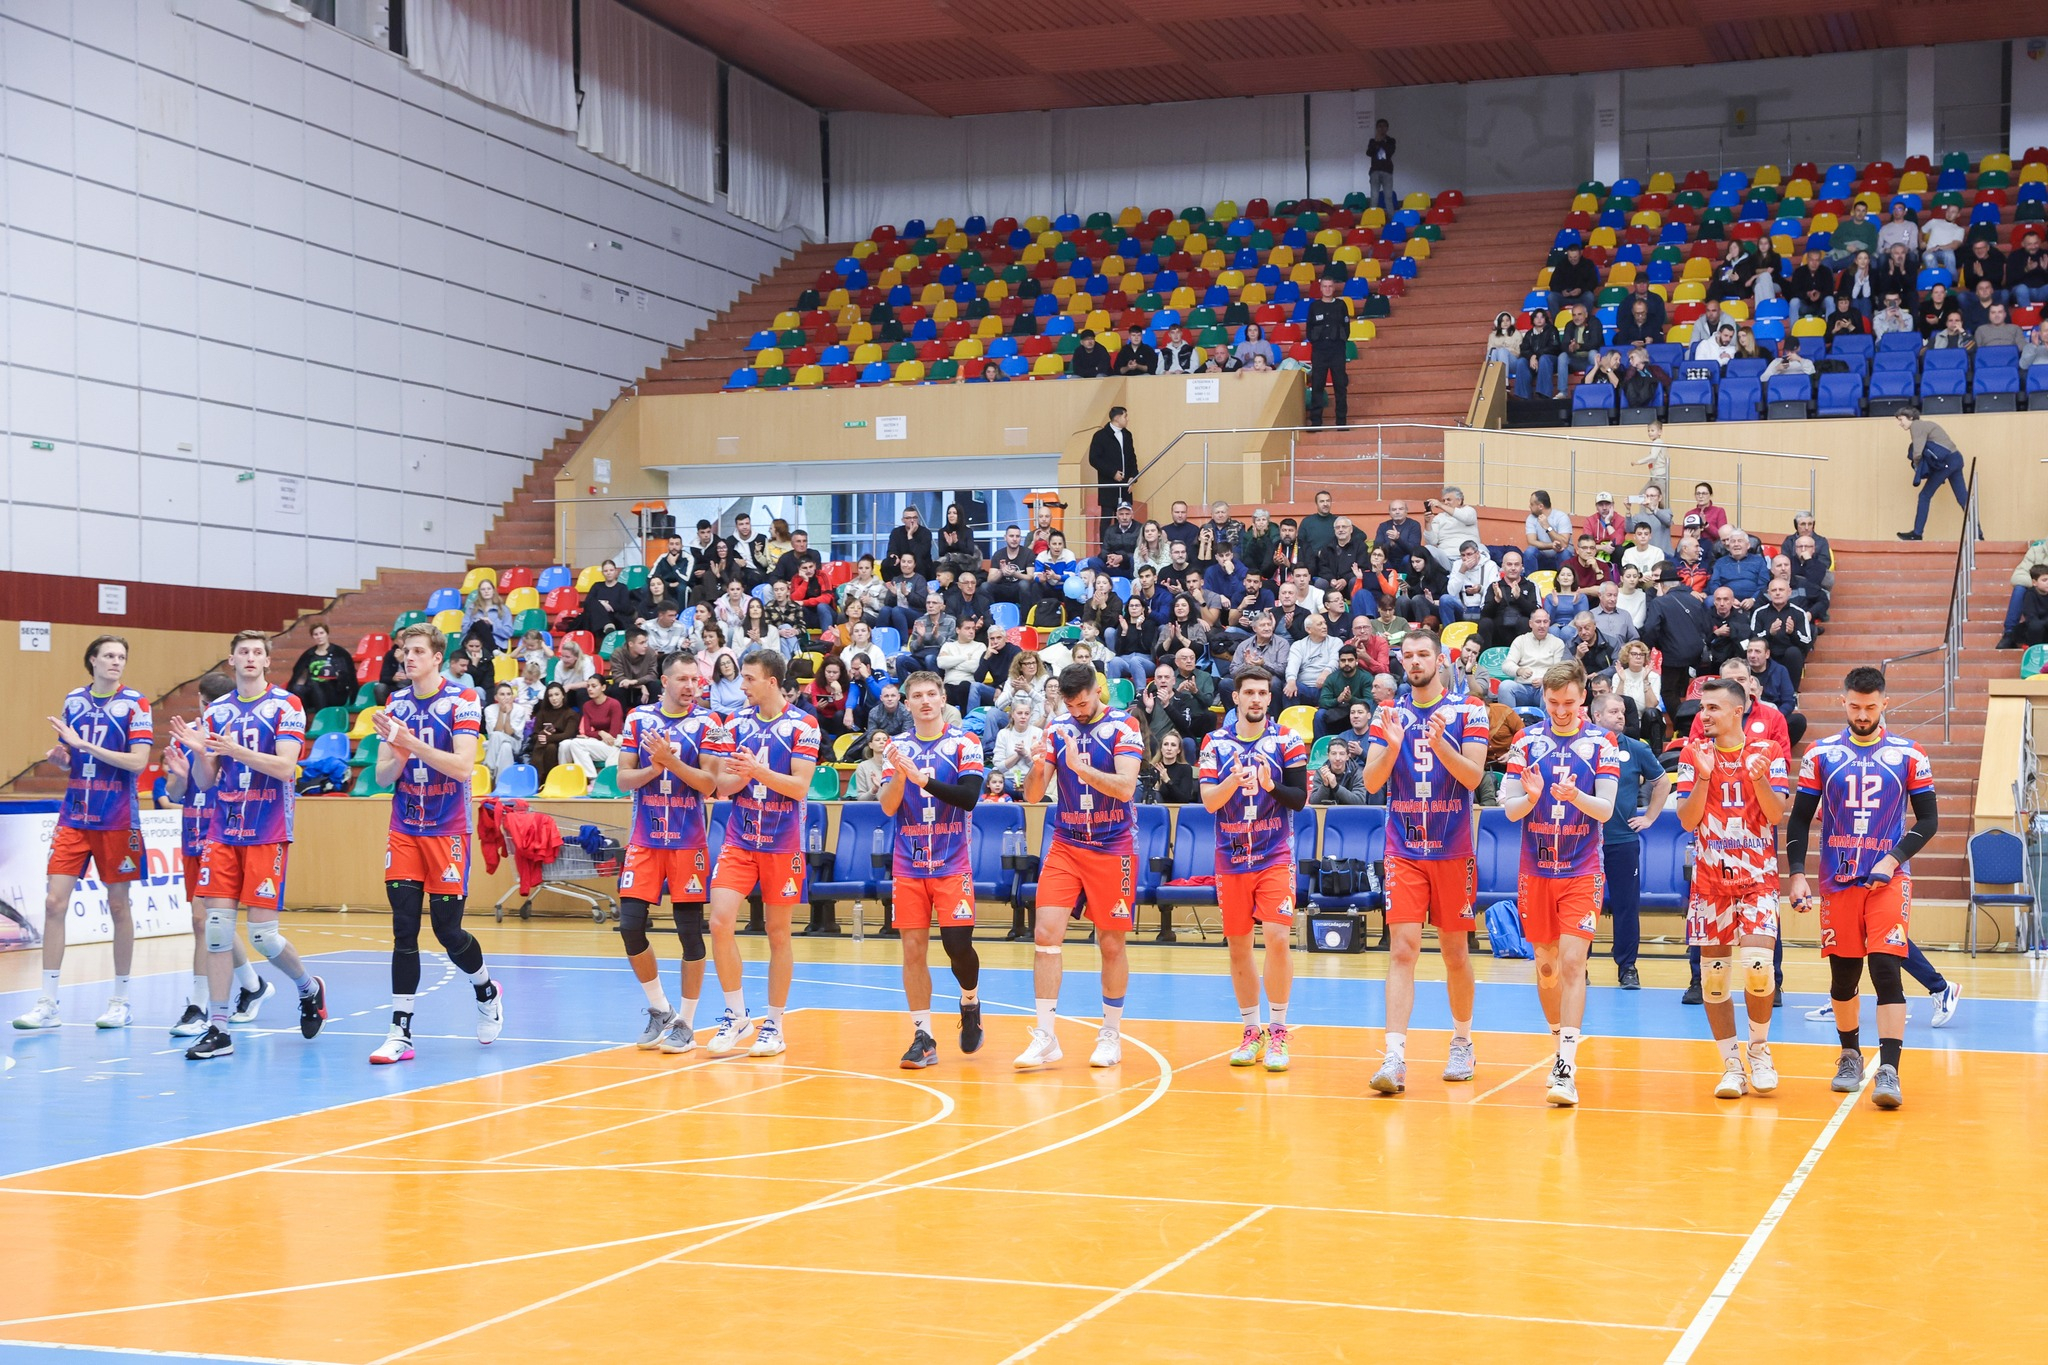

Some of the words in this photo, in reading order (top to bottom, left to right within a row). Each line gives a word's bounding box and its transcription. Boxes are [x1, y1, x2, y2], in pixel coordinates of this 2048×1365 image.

[21, 627, 49, 635] SECTOR
[32, 637, 39, 648] C
[80, 724, 108, 753] 17
[1414, 738, 1434, 772] 5
[1552, 765, 1571, 783] 7
[1720, 781, 1745, 808] 11
[1844, 774, 1883, 809] 12
[450, 835, 462, 862] PCF
[1405, 840, 1443, 849] CAPITAL
[1537, 860, 1572, 869] CAPITAL
[198, 867, 210, 885] 3
[1121, 855, 1131, 897] ISPCF
[1688, 916, 1708, 938] 11
